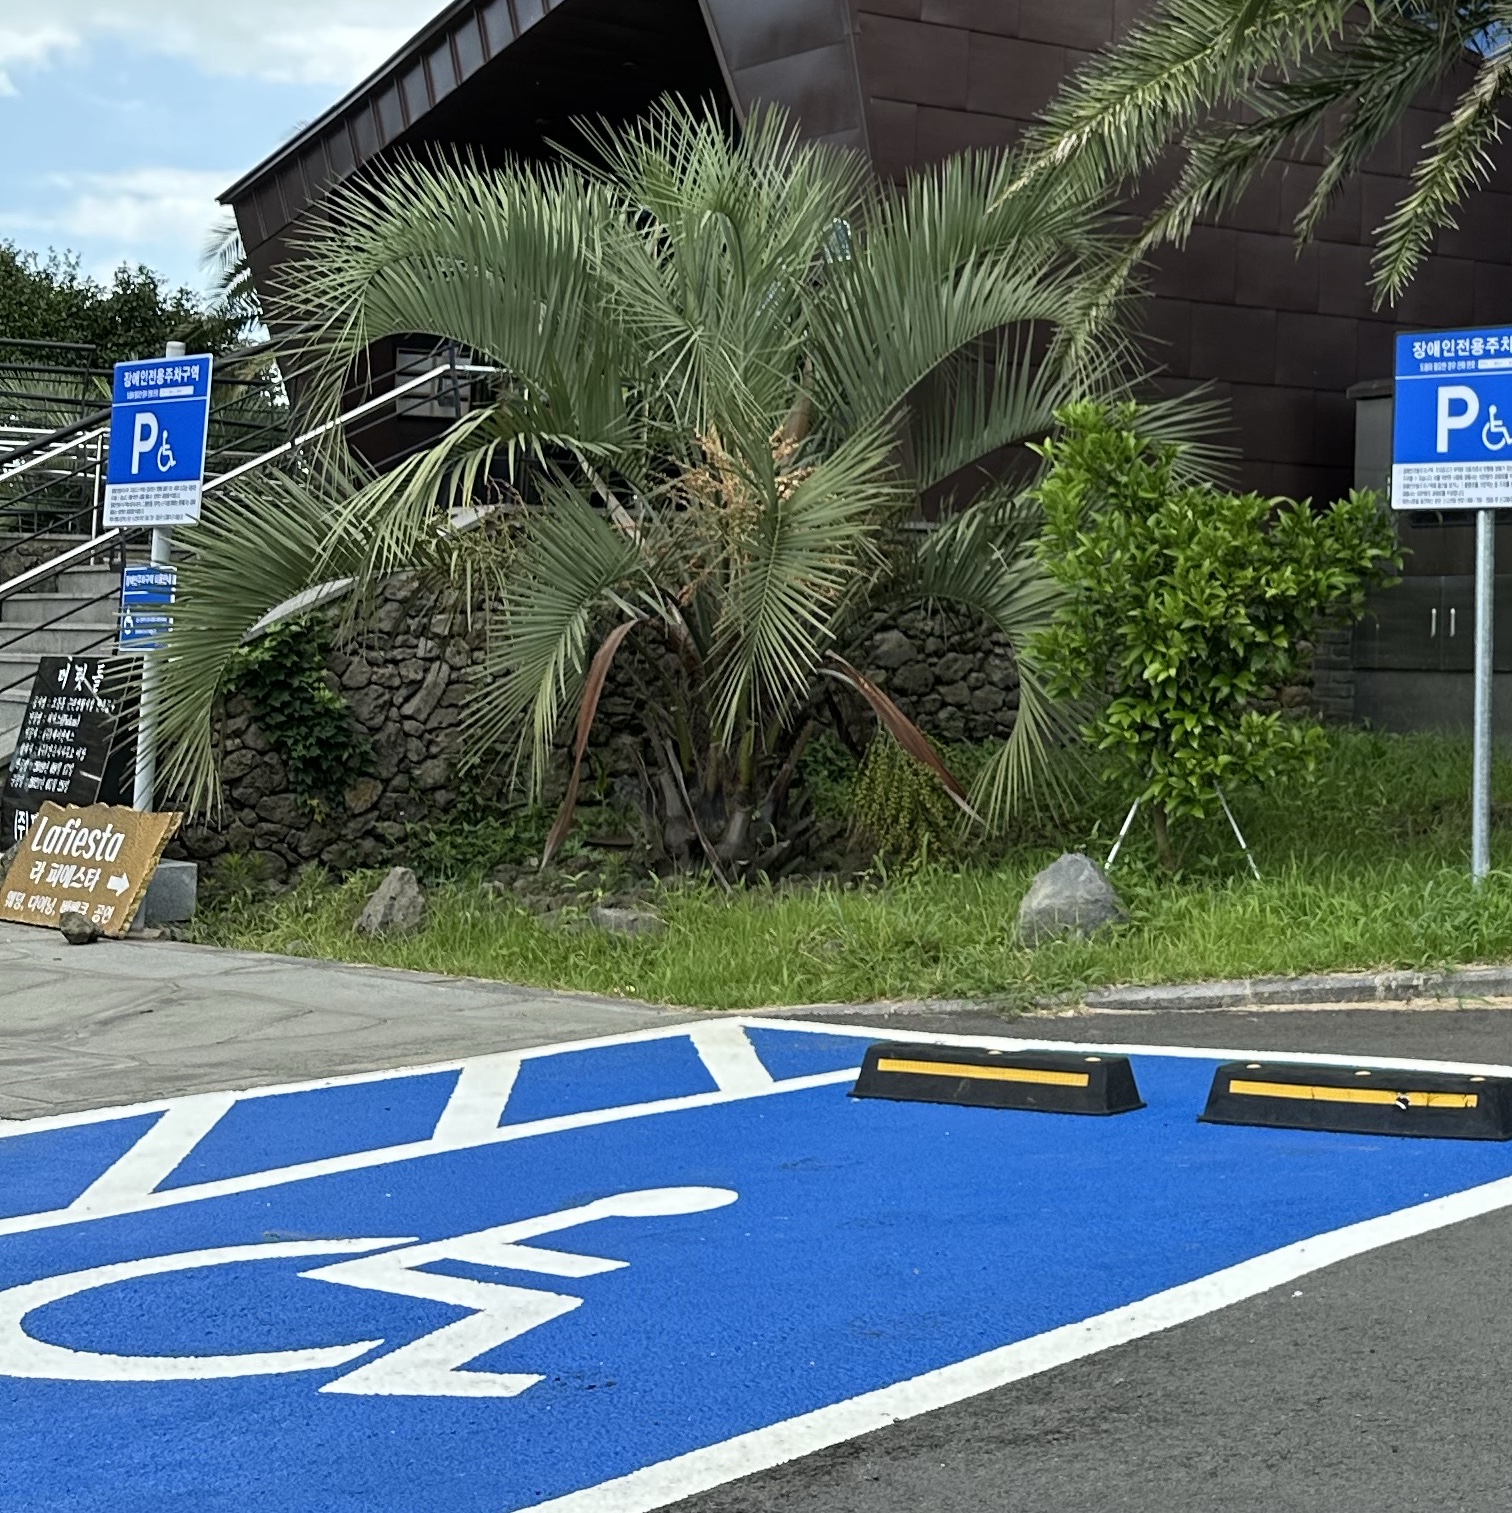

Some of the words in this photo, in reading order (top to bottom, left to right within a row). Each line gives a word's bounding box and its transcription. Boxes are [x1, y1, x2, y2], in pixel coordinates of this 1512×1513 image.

[124, 364, 200, 388] 장애인전용주차구역
[1436, 385, 1480, 454] P
[131, 412, 159, 475] P
[31, 816, 126, 863] Lafiesta
[29, 860, 47, 885] 라
[46, 863, 102, 893] 피에스타
[91, 903, 115, 925] 공연
